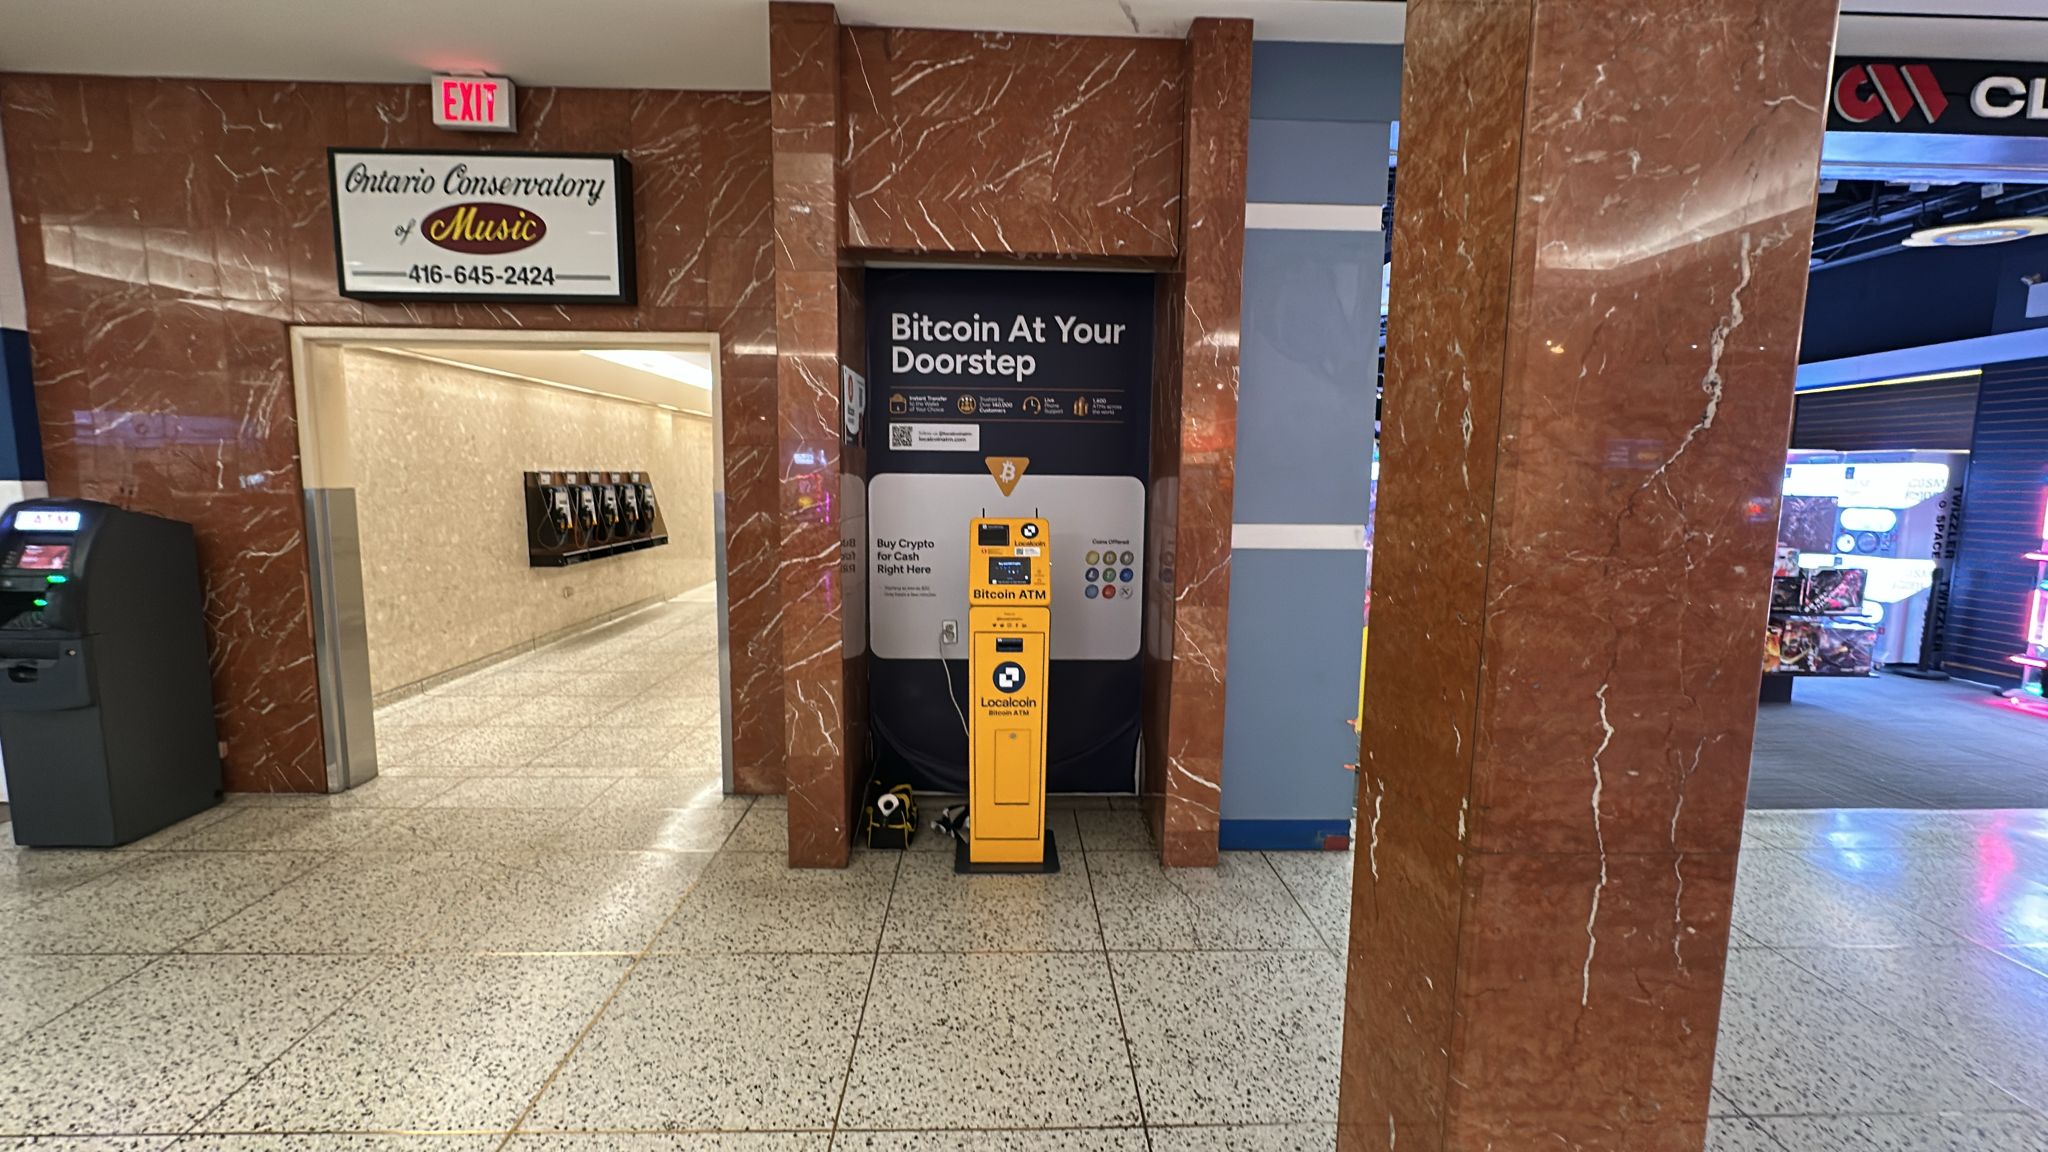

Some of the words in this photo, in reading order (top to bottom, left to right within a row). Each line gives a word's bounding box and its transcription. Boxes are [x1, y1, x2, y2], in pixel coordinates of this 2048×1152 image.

[443, 81, 497, 123] EXIT
[345, 163, 435, 194] Ontario
[443, 163, 605, 206] Conservatory
[395, 218, 416, 244] of
[430, 206, 537, 242] Music
[408, 264, 556, 285] 416-645-2424
[891, 312, 1000, 342] Bitcoin
[1008, 314, 1046, 343] At
[1054, 316, 1126, 345] Your
[892, 345, 1036, 382] Doorstep
[877, 538, 896, 550] Buy
[899, 538, 935, 550] Crypto
[877, 552, 892, 561] for
[894, 552, 919, 561] Cash
[877, 564, 904, 576] Right
[906, 564, 931, 574] Here
[974, 589, 1016, 599] Bitcoin
[1019, 590, 1046, 600] ATM
[980, 696, 1037, 708] Localcoin
